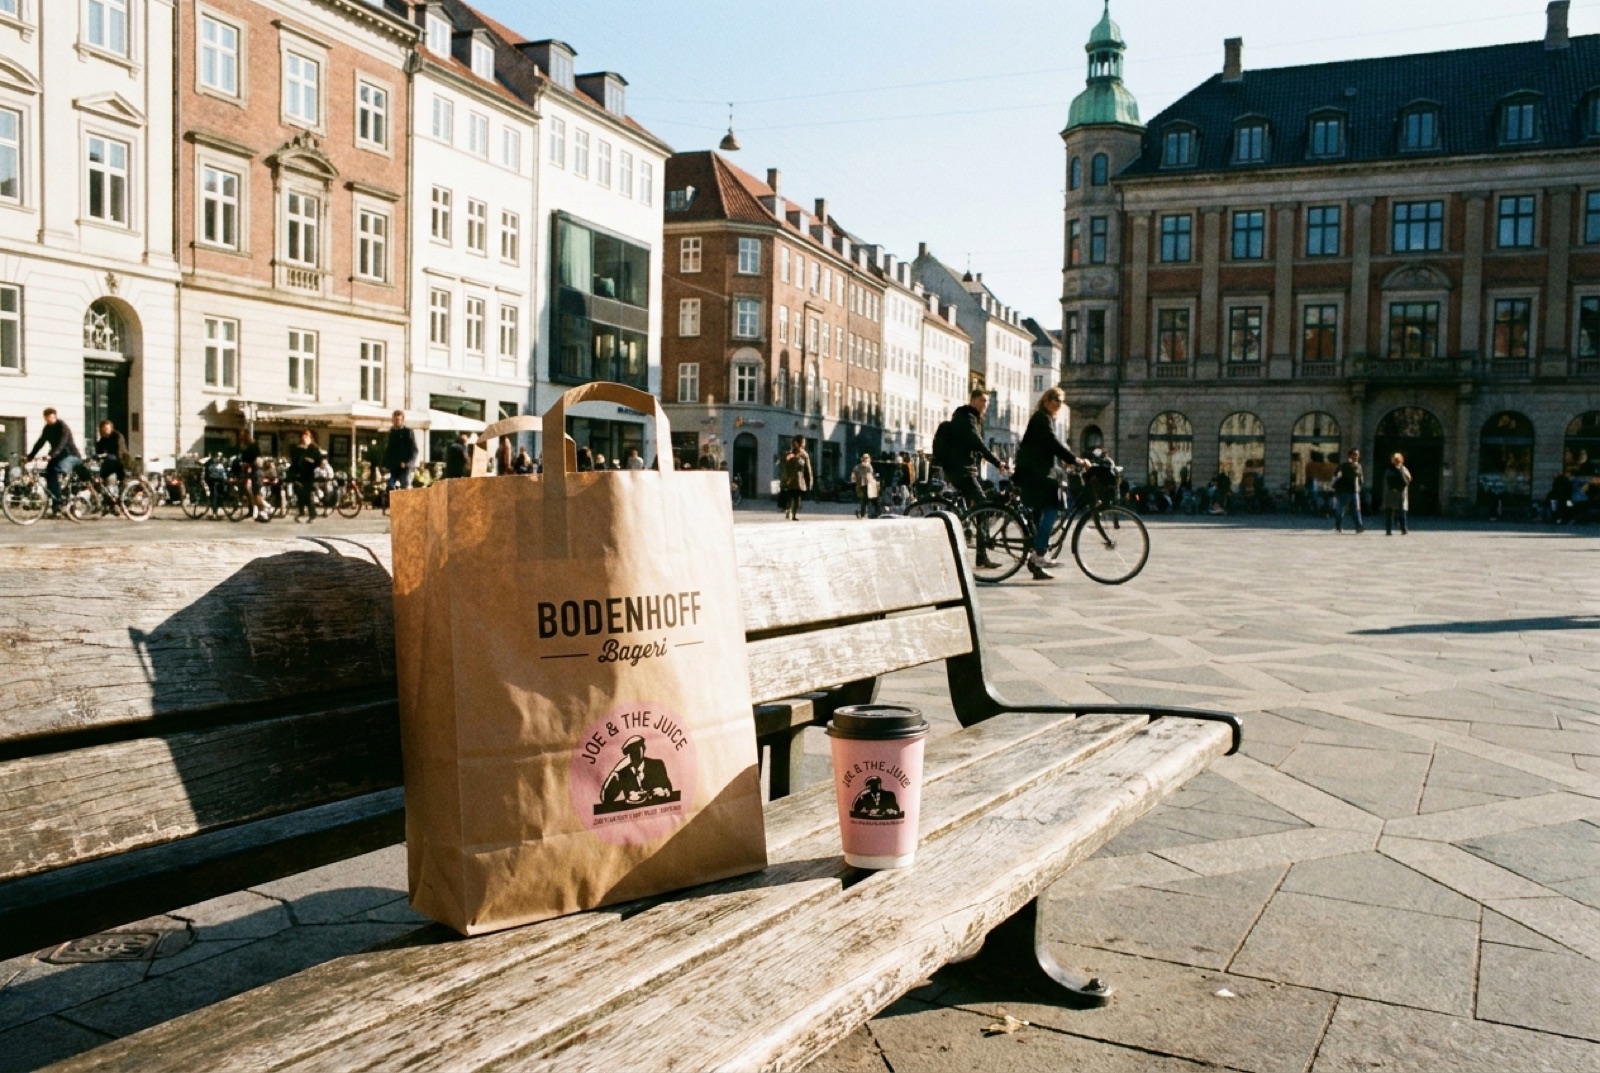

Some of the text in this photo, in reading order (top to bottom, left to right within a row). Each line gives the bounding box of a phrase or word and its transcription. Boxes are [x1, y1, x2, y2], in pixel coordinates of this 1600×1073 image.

[537, 591, 701, 639] BODENHOFF
[597, 637, 668, 667] Bageri
[581, 710, 688, 765] JOE & THE JUICE
[863, 761, 886, 771] THE
